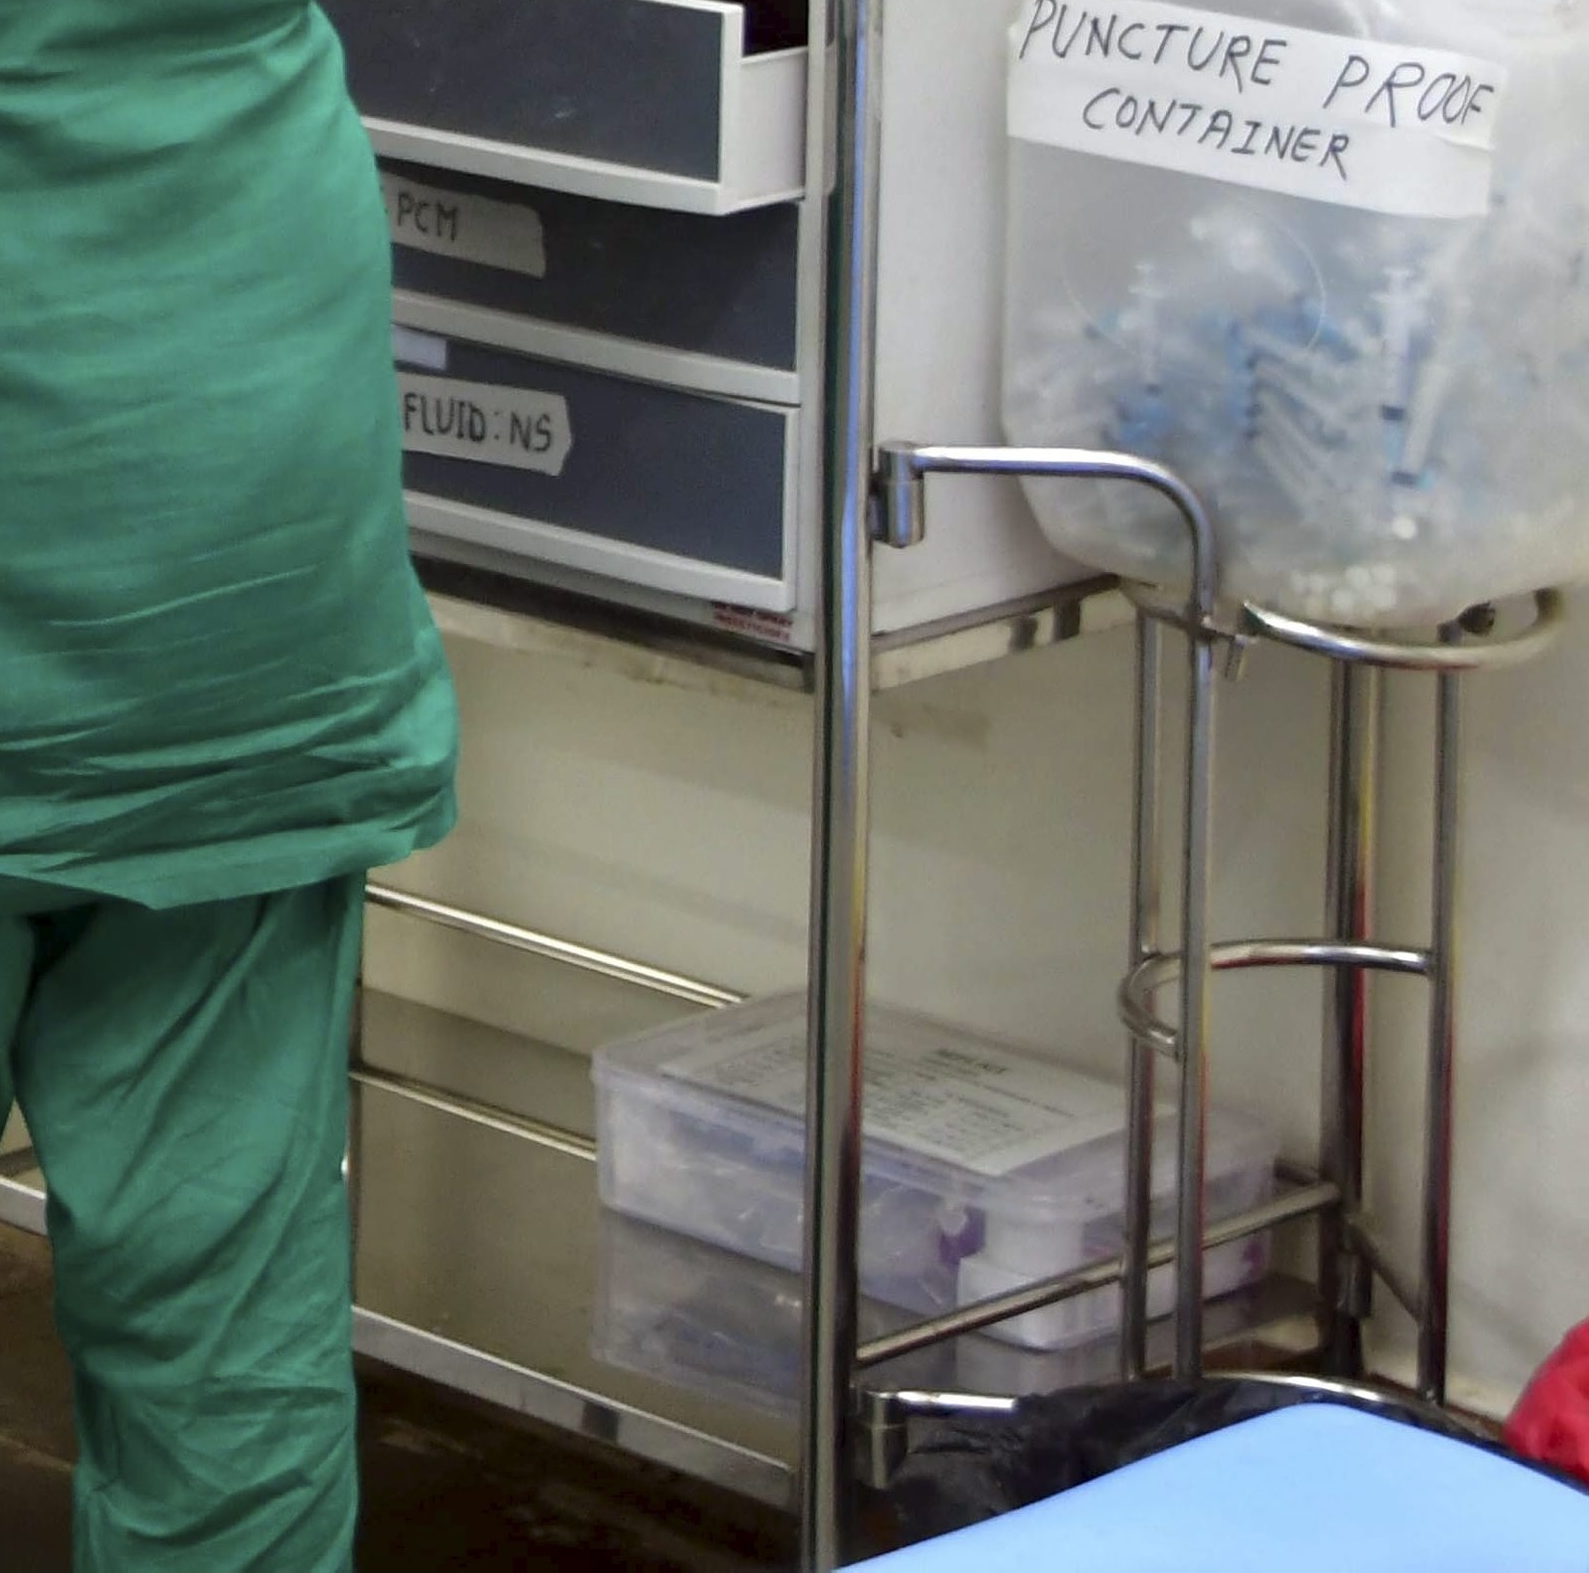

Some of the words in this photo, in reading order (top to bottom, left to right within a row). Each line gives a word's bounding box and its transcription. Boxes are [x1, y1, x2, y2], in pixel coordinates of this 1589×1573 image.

[1322, 54, 1496, 128] PROOF
[1081, 86, 1351, 182] CONTAINER
[396, 191, 458, 243] PCM
